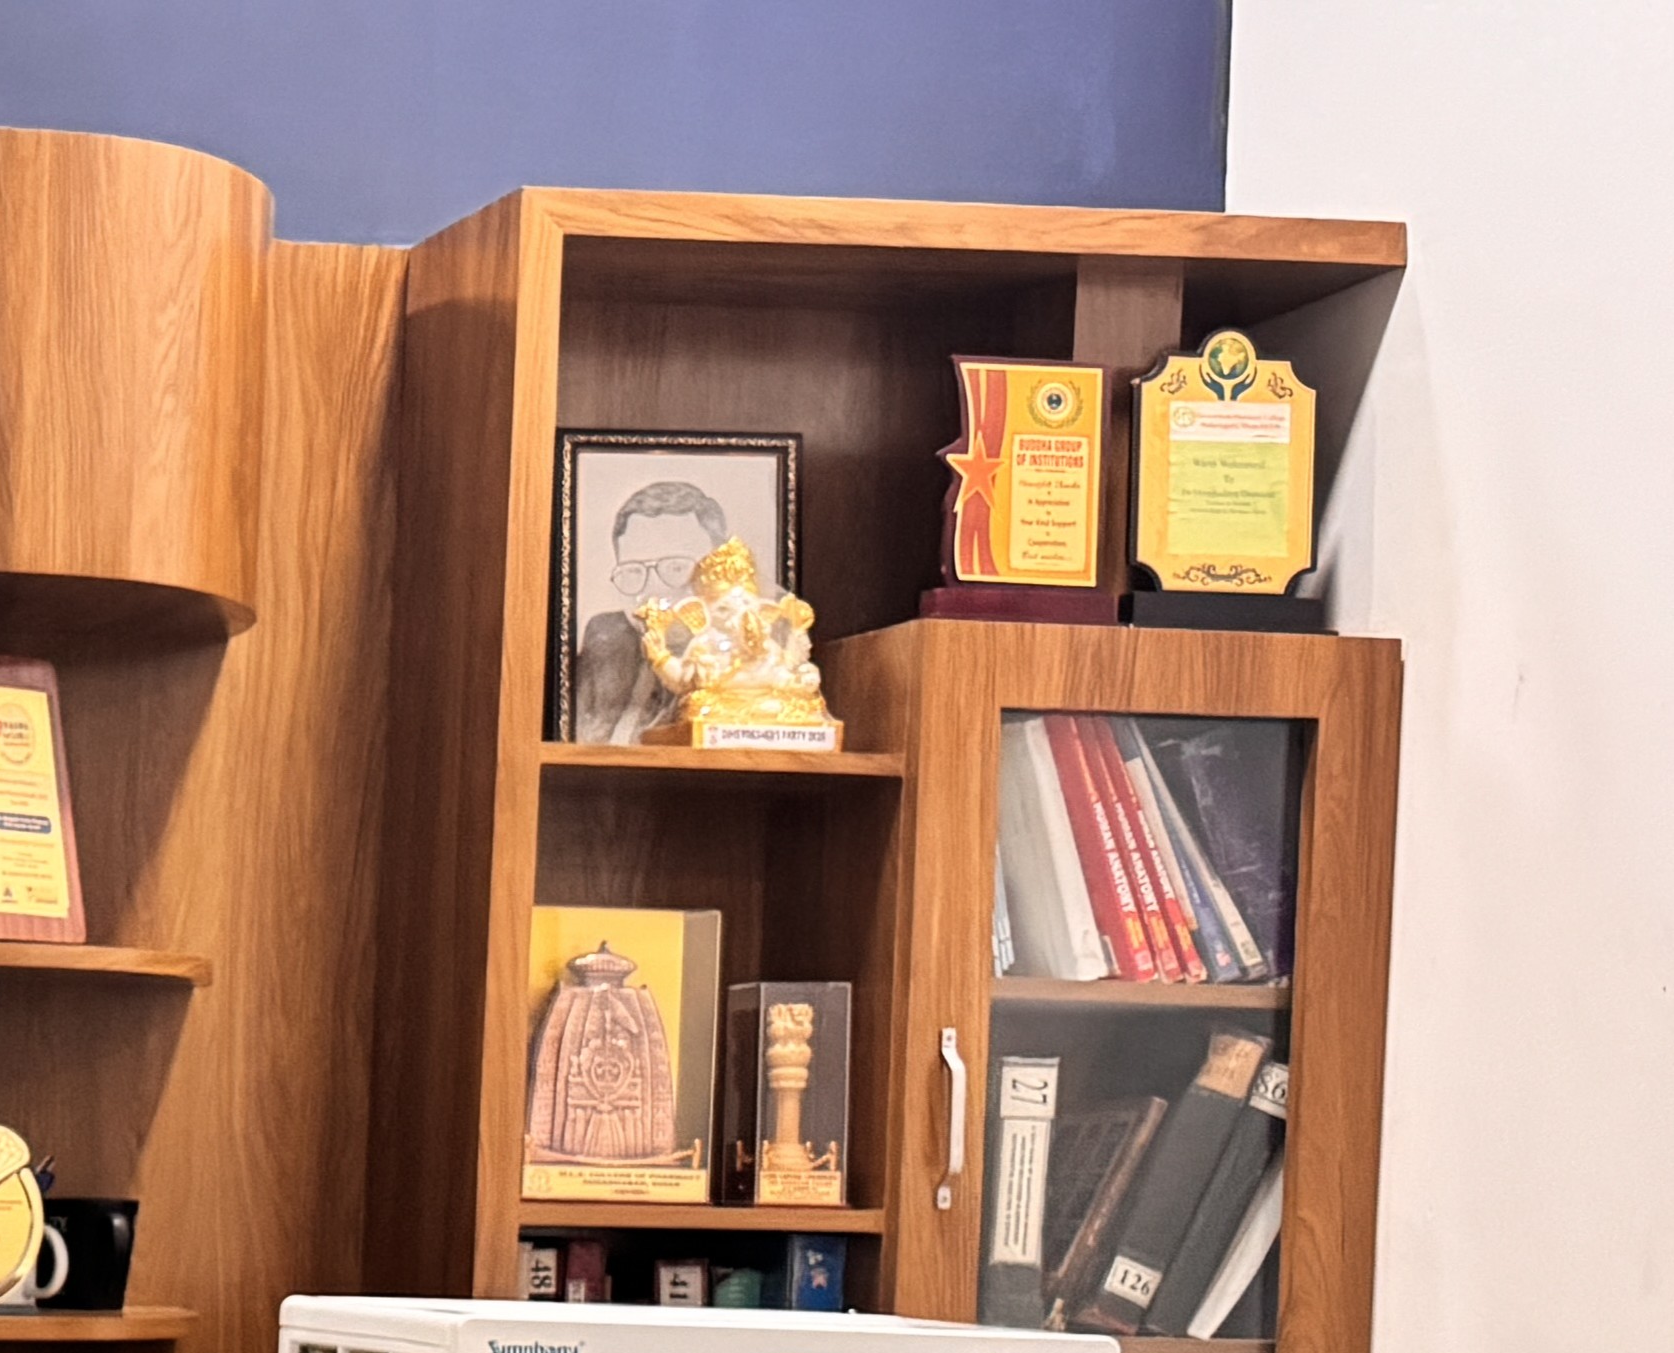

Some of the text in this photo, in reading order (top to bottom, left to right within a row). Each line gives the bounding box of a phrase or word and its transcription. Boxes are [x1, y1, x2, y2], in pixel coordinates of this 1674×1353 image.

[1019, 439, 1082, 452] BUDDHA GROUP
[1016, 454, 1084, 468] OF INSTITUTIONS
[1093, 802, 1136, 912] HUMAN ANATOMY
[1115, 802, 1159, 911] HUMAN ANATOMY
[1120, 1269, 1150, 1297] 126
